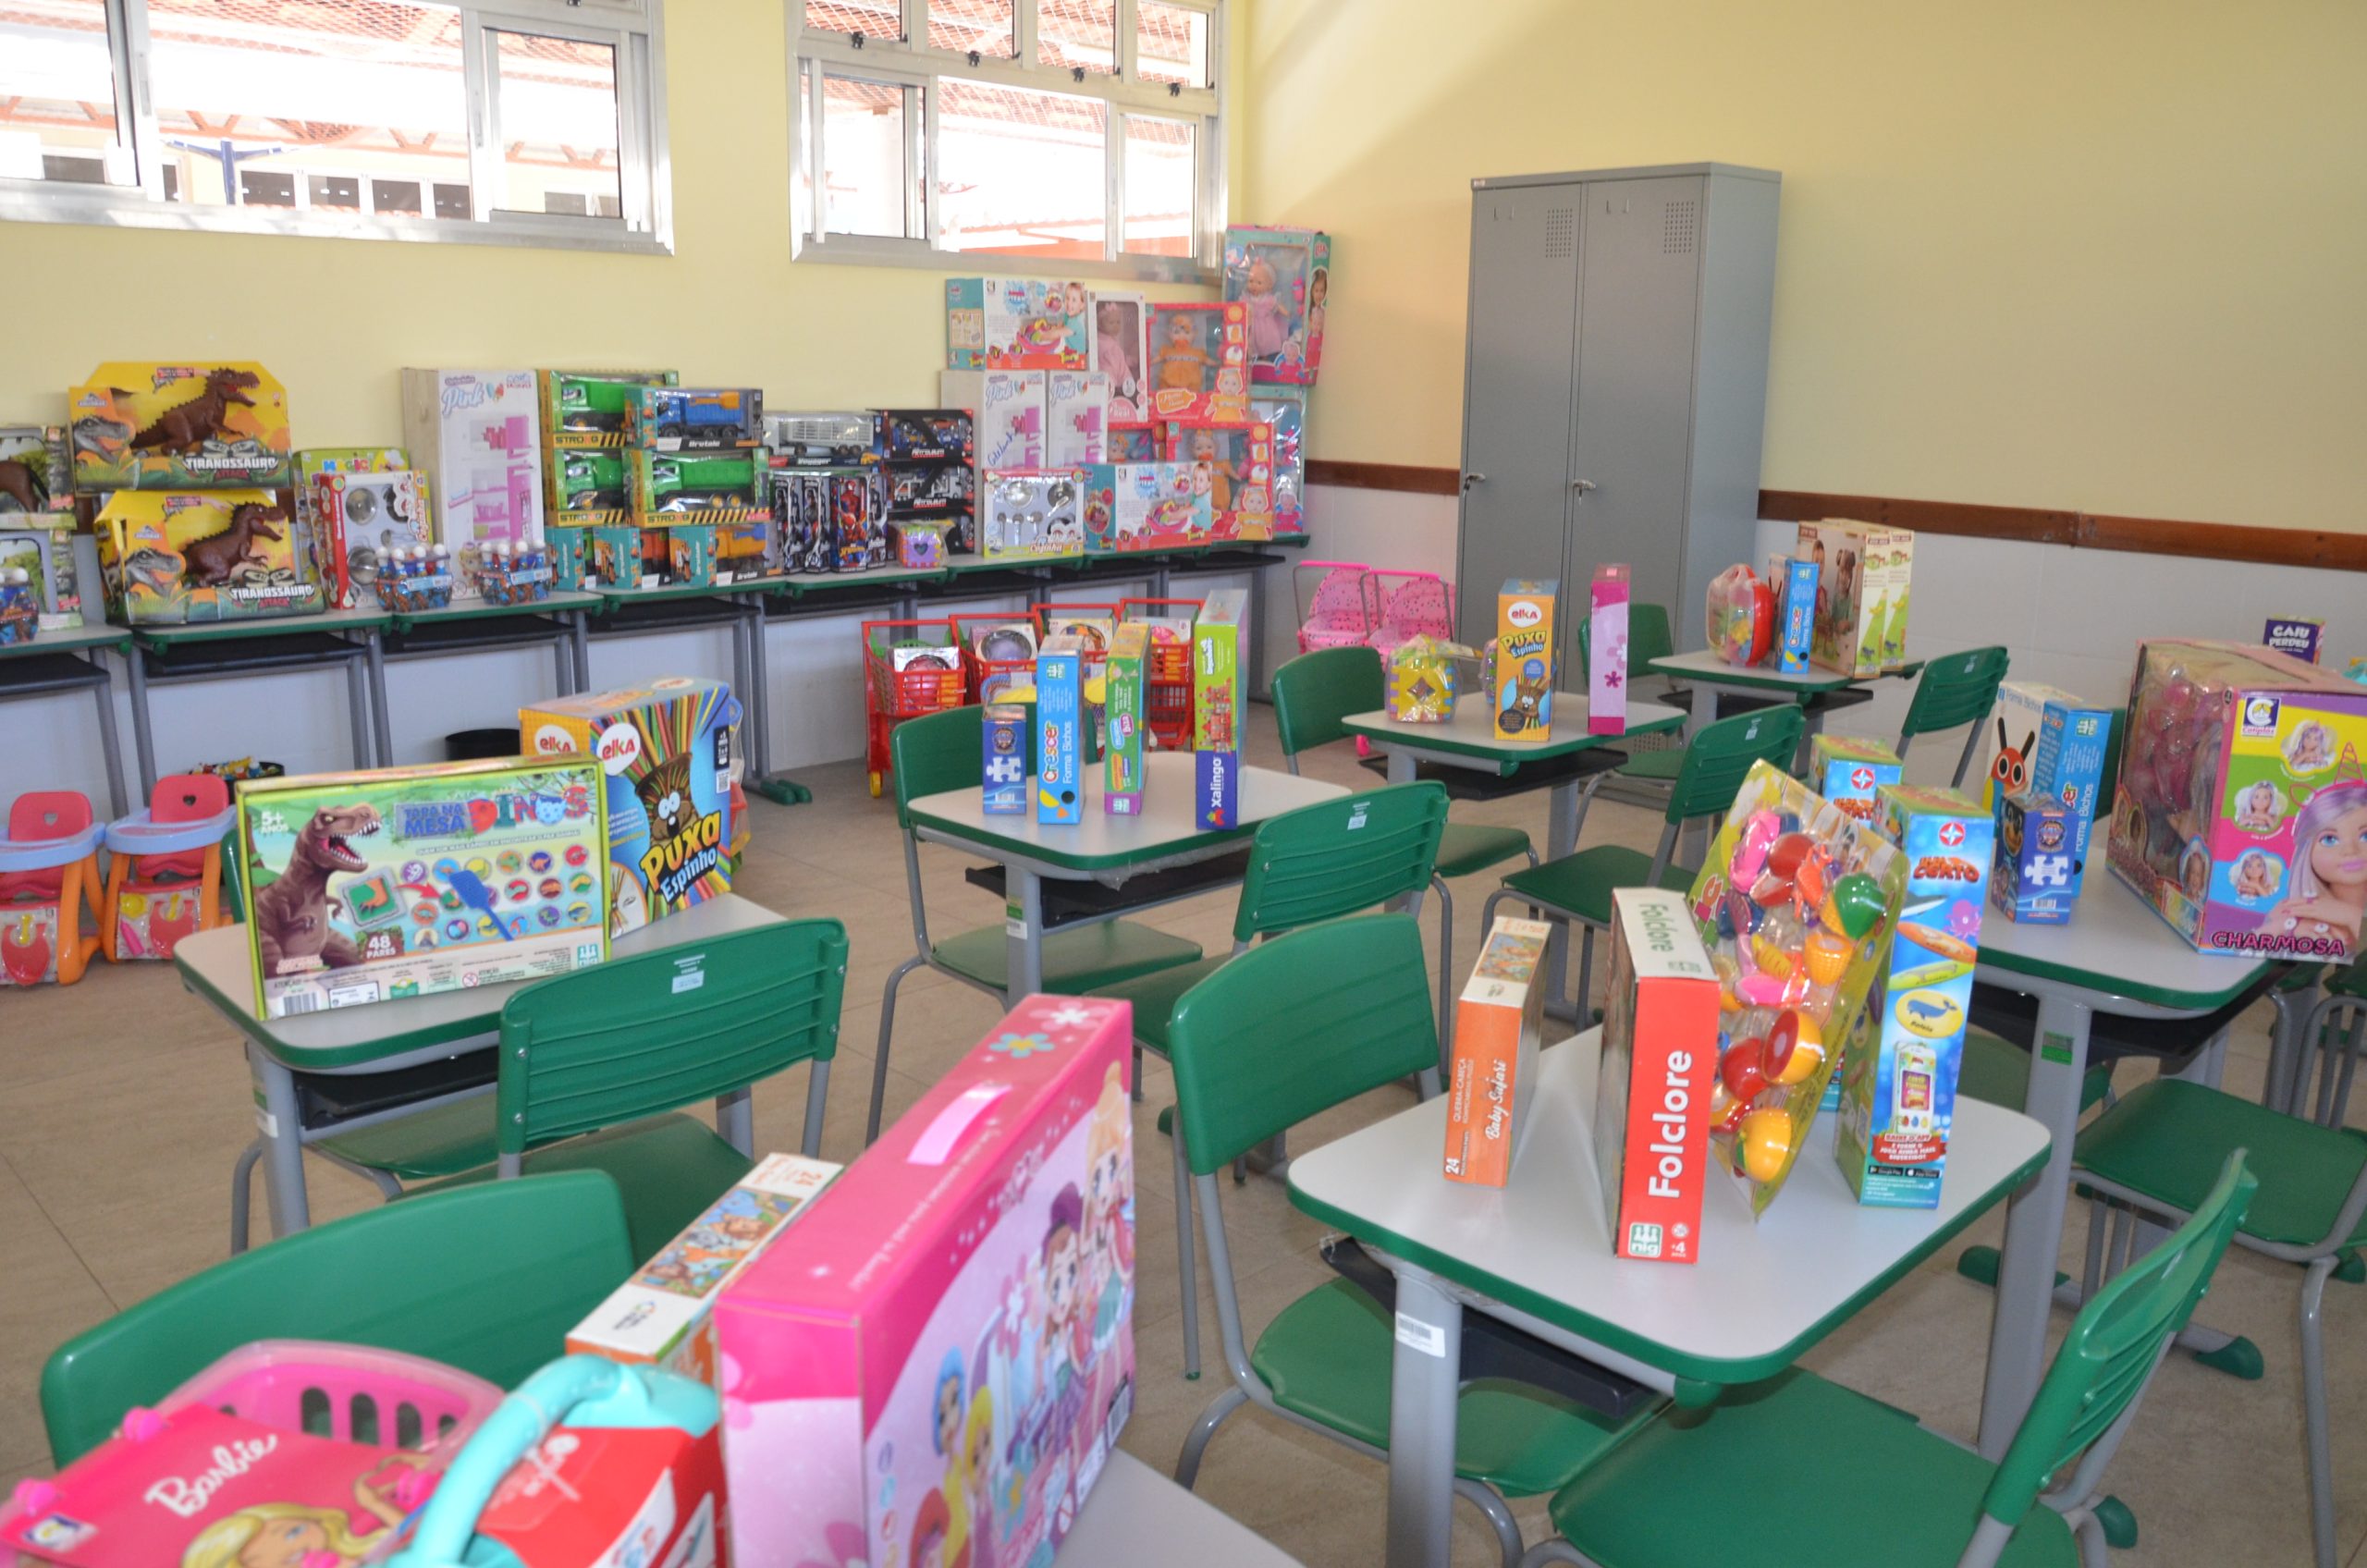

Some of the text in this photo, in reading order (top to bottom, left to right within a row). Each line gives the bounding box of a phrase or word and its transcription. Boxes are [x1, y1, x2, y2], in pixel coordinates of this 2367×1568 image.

[184, 458, 279, 470] TIRANOSSAURO
[230, 584, 315, 600] TIRANOSSAURO
[2268, 636, 2310, 649] PERDEU
[2273, 625, 2310, 639] CAIU
[1511, 643, 1543, 659] Espinho
[1043, 720, 1059, 783] Crescer
[1062, 721, 1073, 784] Forma Bichos
[404, 803, 465, 818] TAPA NA
[467, 785, 591, 835] DINOS
[2079, 784, 2094, 816] Bichos
[404, 814, 466, 837] MESA
[660, 847, 717, 902] Espinho
[1640, 902, 1675, 953] Folclore
[366, 947, 396, 959] PARES
[368, 935, 391, 949] 48
[2211, 931, 2345, 957] CHARMOSA
[1485, 1060, 1509, 1140] Baby Safari
[1648, 1050, 1692, 1199] Folclore
[1445, 1158, 1460, 1174] 24
[143, 1434, 278, 1518] Barbie
